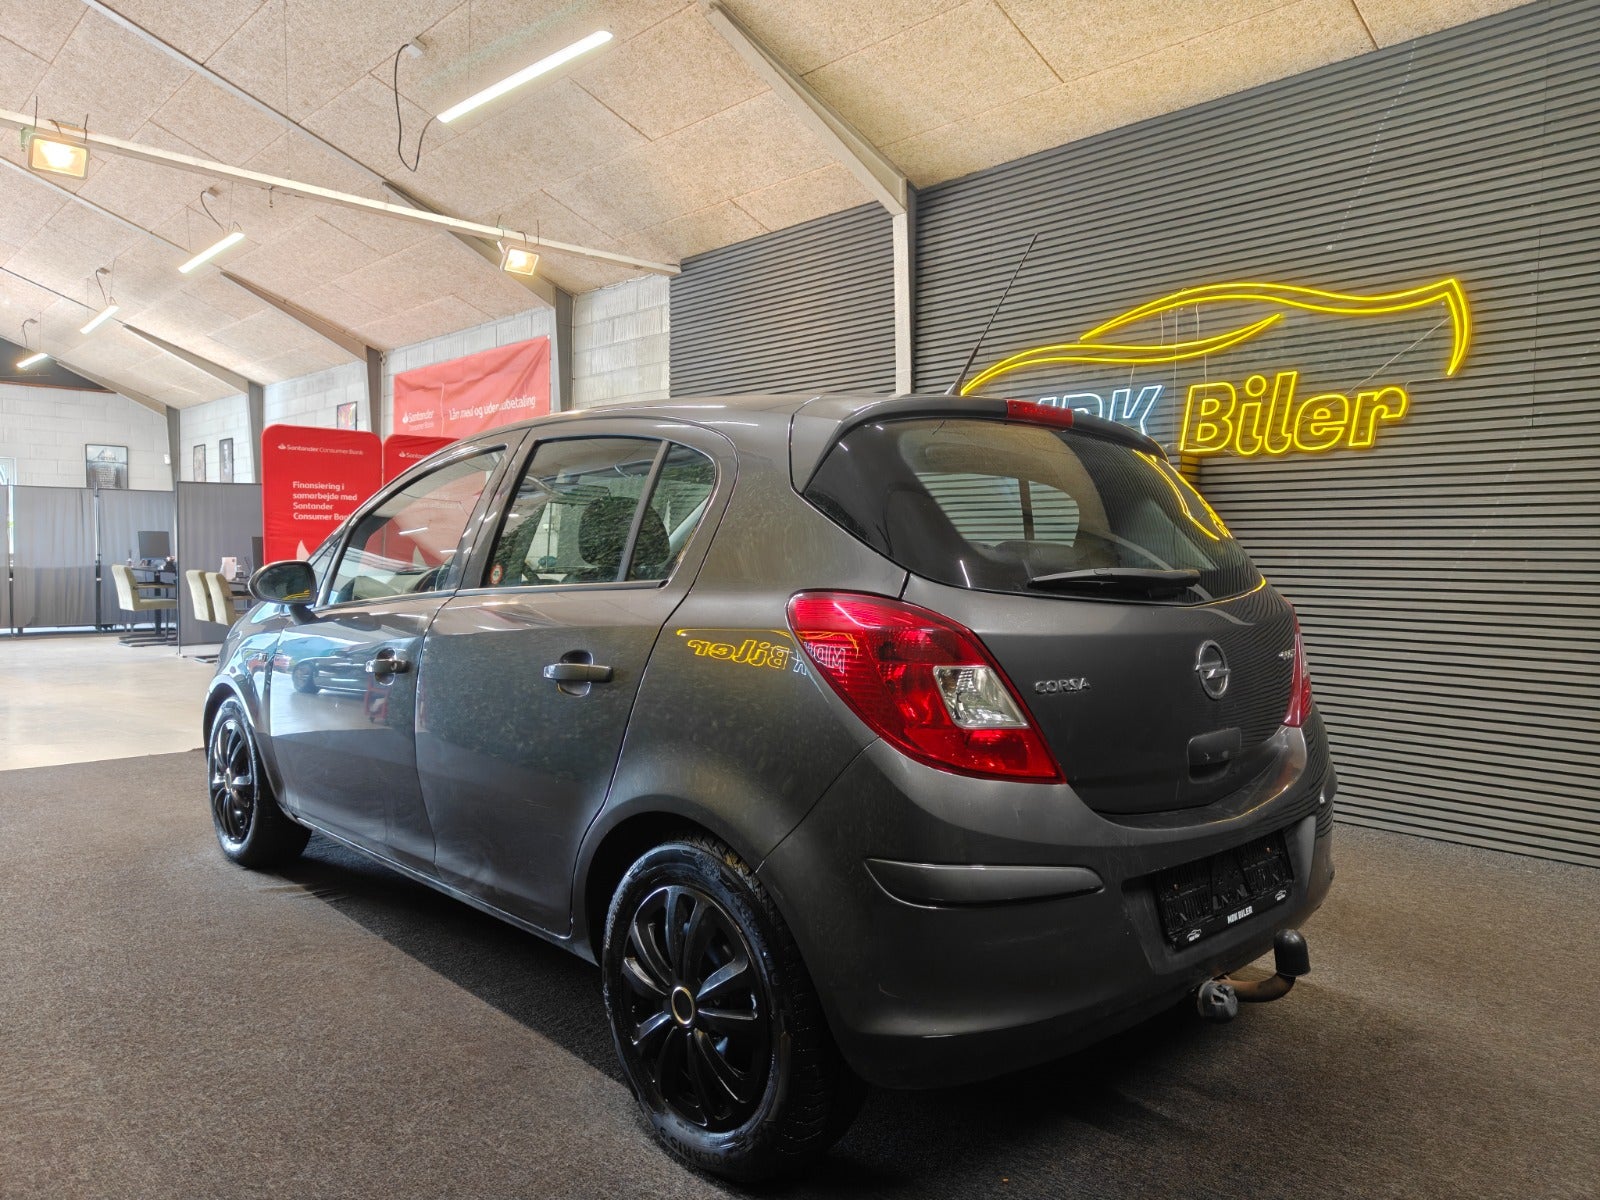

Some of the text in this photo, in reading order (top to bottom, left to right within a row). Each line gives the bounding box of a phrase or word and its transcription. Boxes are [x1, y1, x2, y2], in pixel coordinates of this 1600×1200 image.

[474, 406, 484, 419] og
[1180, 370, 1409, 457] Biler
[286, 444, 319, 453] Santander
[319, 446, 348, 455] Consumer
[292, 481, 341, 492] Finansiering
[292, 492, 358, 502] samarbejde med
[292, 502, 334, 511] Santander
[293, 512, 332, 521] Consumer
[1034, 677, 1091, 695] CORSA
